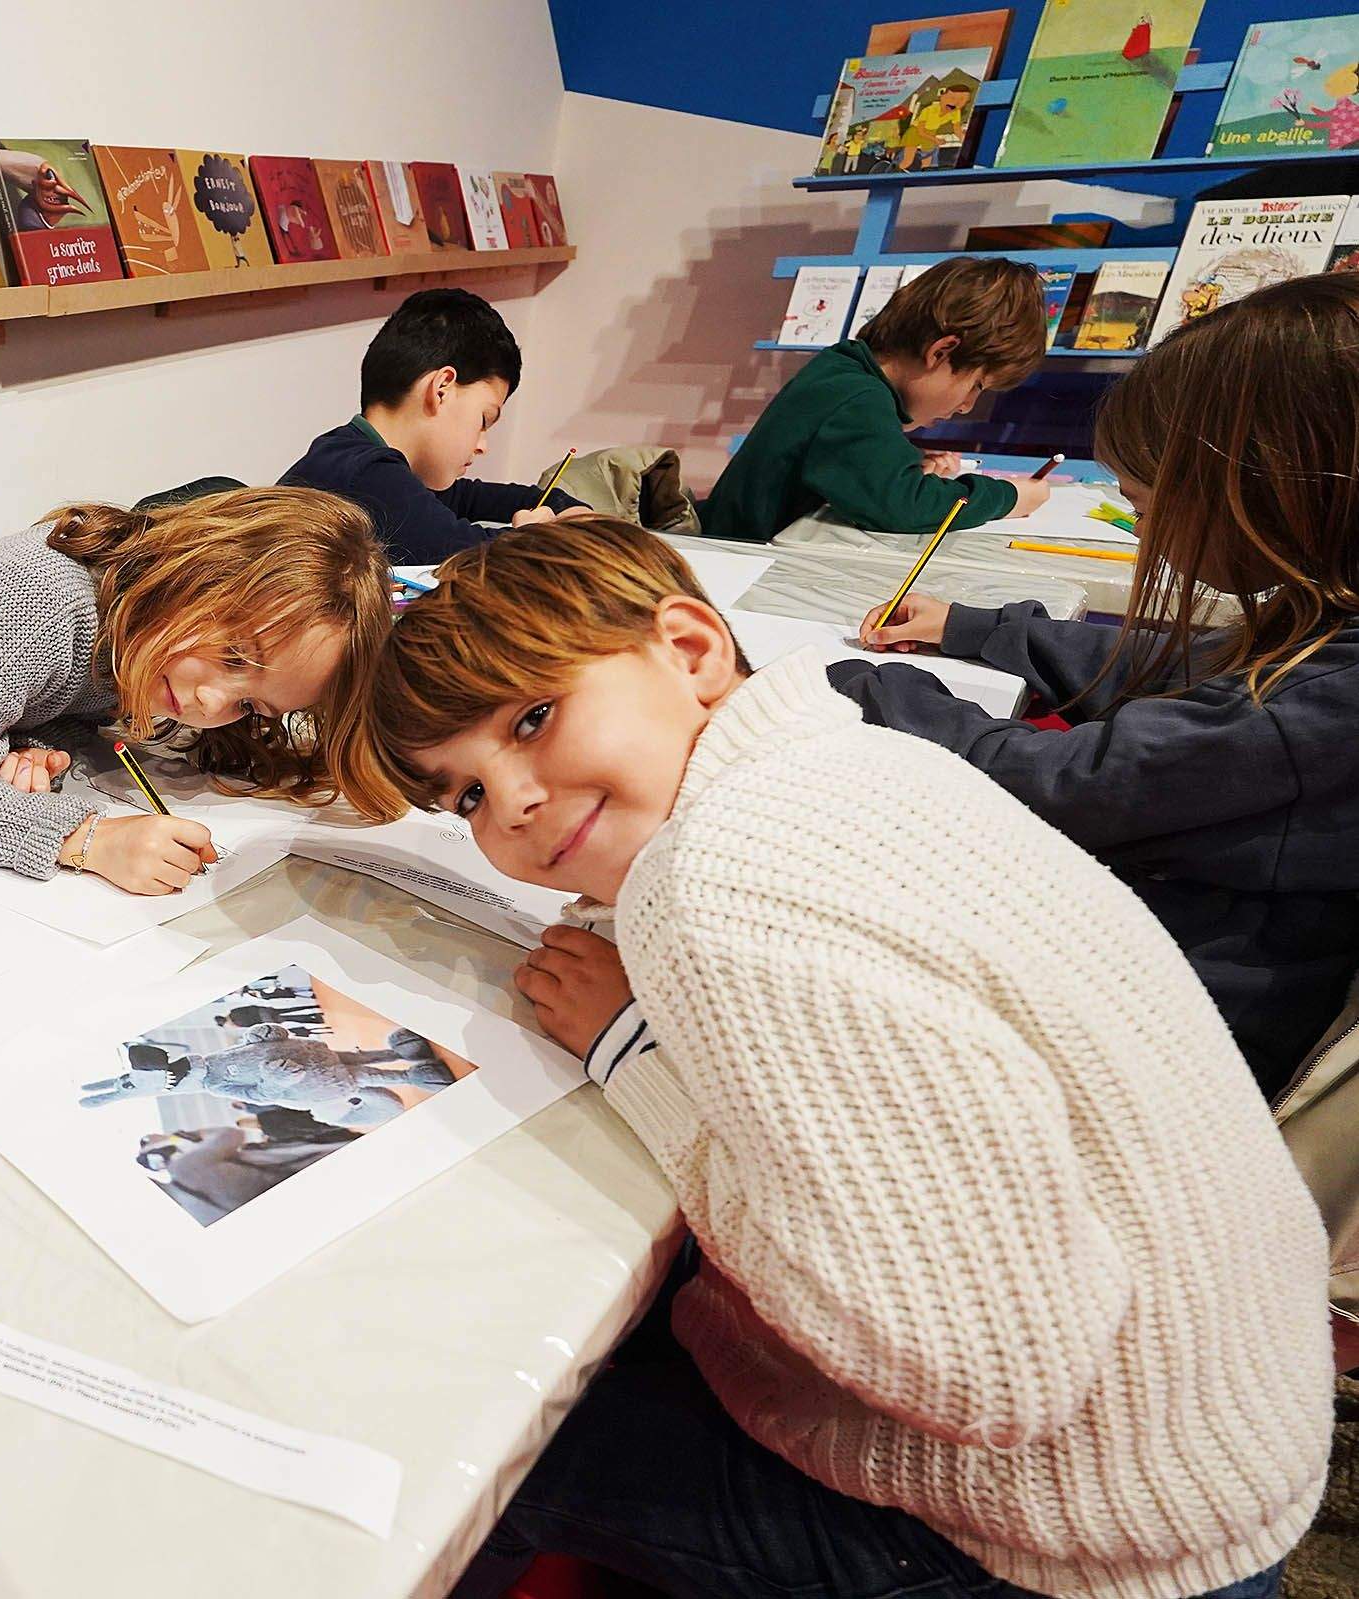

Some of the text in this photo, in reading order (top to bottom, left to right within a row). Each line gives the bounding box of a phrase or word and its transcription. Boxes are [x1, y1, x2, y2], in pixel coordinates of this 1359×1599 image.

[1220, 127, 1313, 145] Une abeille
[1207, 213, 1335, 226] LE DOMAINE
[1200, 225, 1324, 245] des dieux
[61, 237, 96, 257] sorcière
[47, 258, 101, 285] grince-dents
